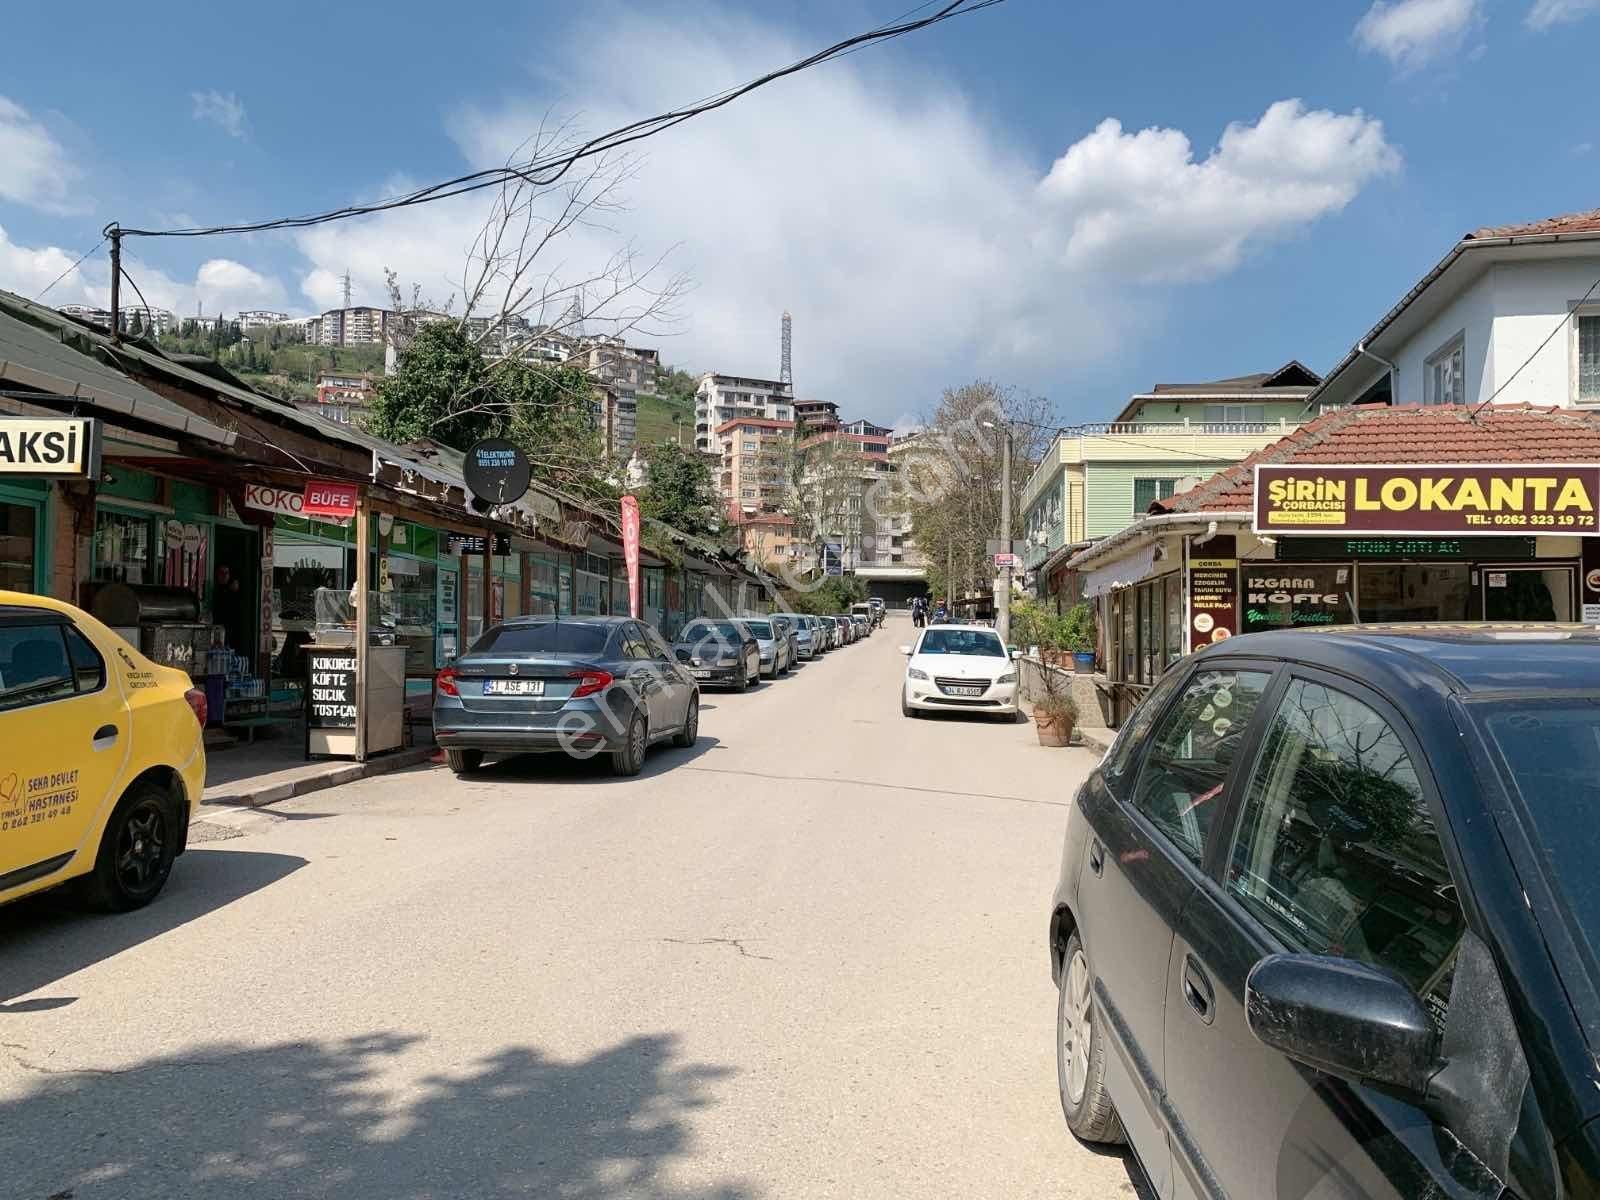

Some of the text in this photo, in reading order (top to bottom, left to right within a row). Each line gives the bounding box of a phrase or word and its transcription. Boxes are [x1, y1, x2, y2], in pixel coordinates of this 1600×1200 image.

[310, 490, 350, 507] BÜFE
[1269, 477, 1346, 507] ŞİRİN
[1354, 478, 1593, 511] LOKANTA
[1283, 501, 1346, 512] ÇORBACISI
[1465, 514, 1594, 526] TEL: 0262 323 19 72
[1248, 590, 1339, 604] KÖFTE
[312, 672, 347, 686] KÖFTE
[505, 680, 522, 691] ASE
[527, 681, 540, 691] 131
[312, 688, 346, 701] SUCUK
[50, 769, 79, 787] DEVLET
[28, 790, 79, 812] HASTANESİ
[2, 821, 9, 831] 0
